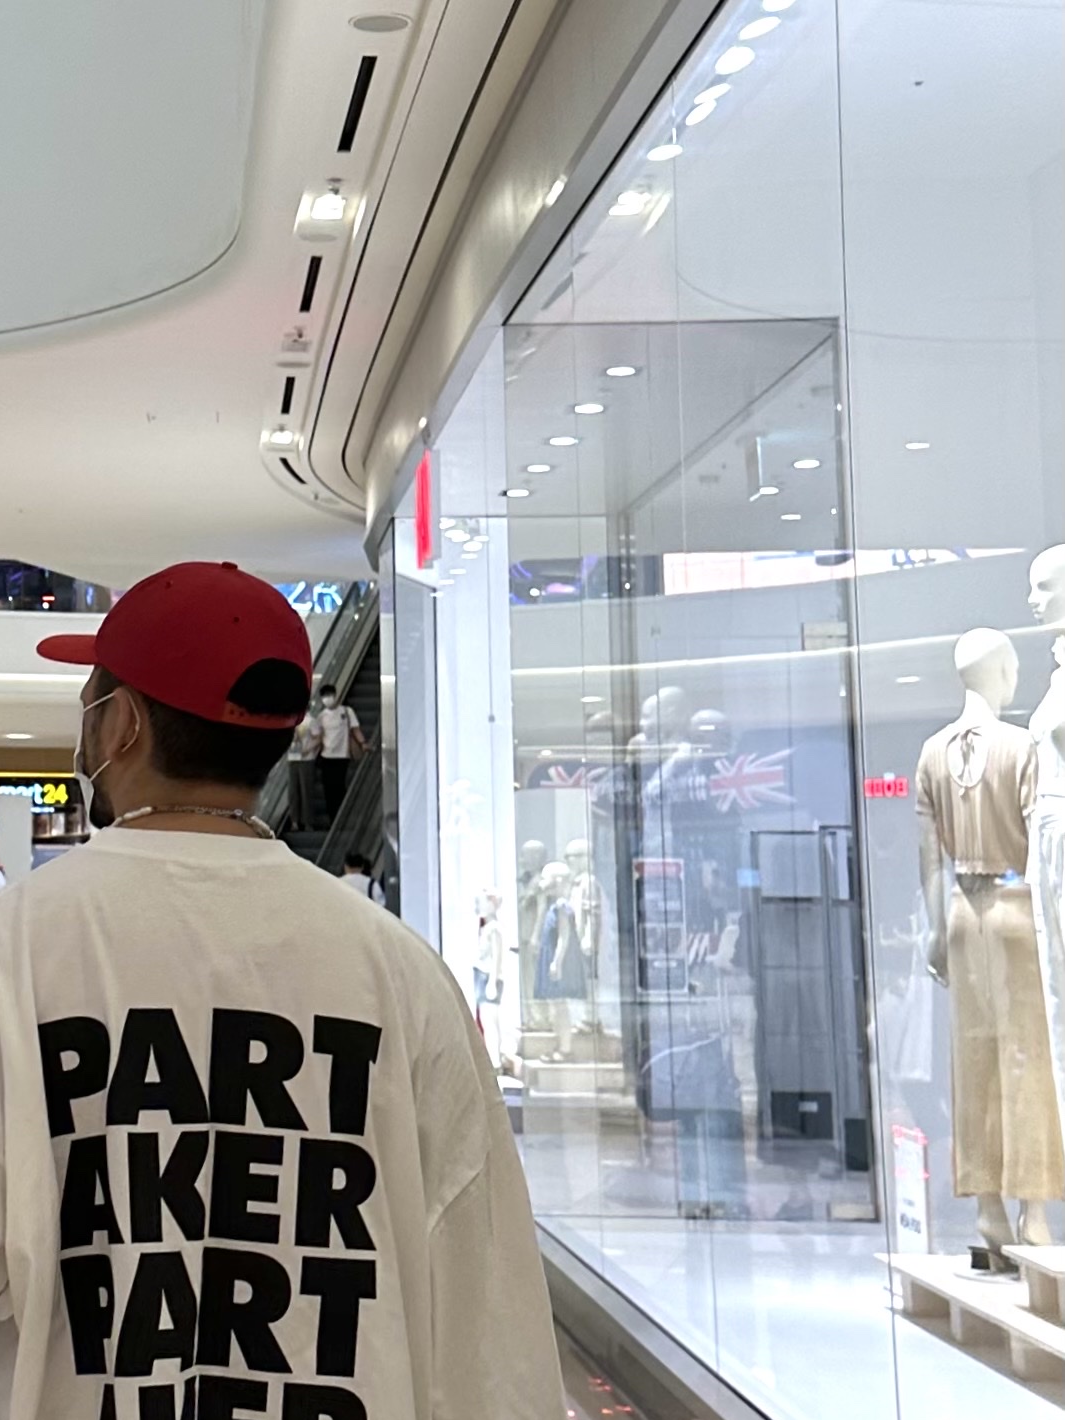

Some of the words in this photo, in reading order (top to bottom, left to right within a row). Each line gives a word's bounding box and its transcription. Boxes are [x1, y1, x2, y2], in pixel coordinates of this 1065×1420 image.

[38, 1008, 382, 1138] PART
[60, 1131, 377, 1251] AKER
[60, 1247, 377, 1378] PART
